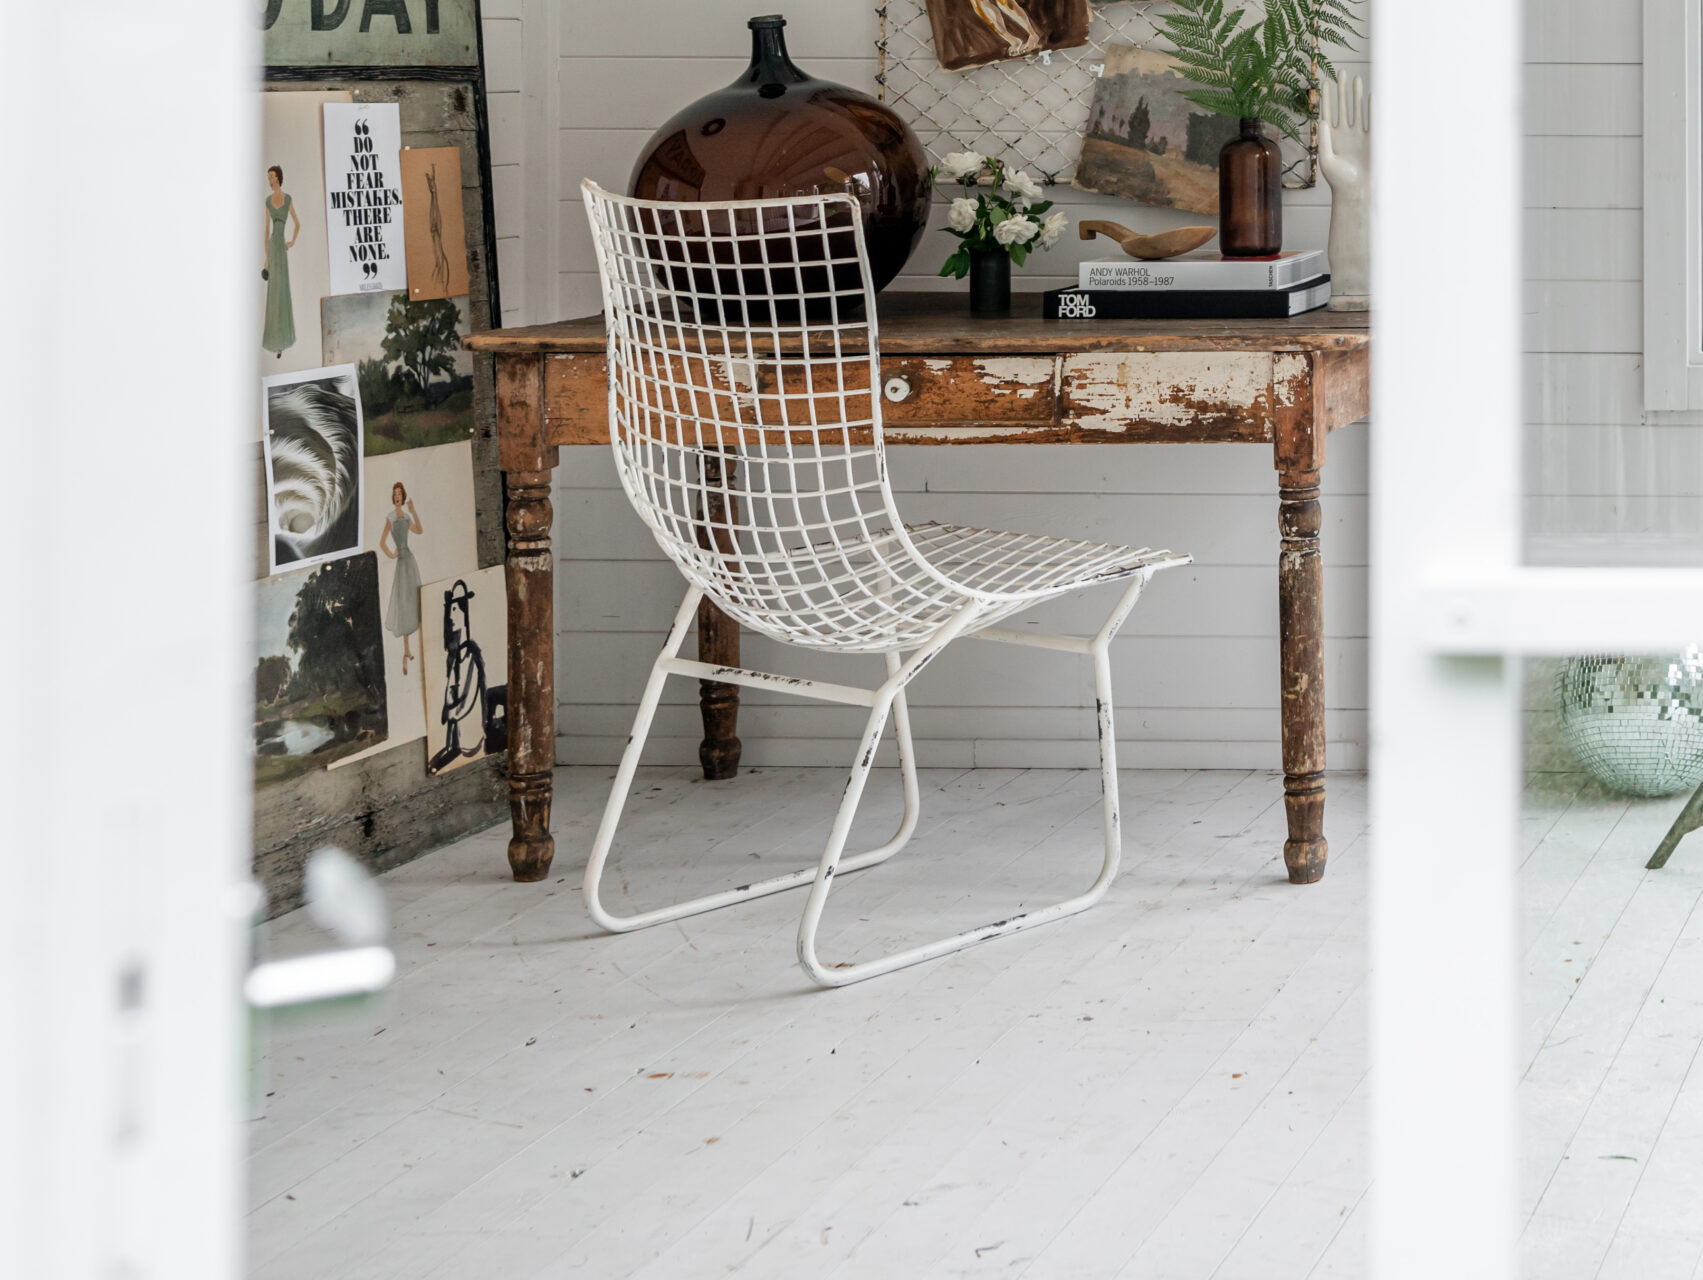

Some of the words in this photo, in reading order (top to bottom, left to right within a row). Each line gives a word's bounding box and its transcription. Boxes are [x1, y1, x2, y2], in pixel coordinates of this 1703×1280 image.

[353, 136, 373, 154] DO
[350, 154, 379, 172] NOT
[346, 171, 384, 190] FEAR
[330, 189, 402, 209] MISTAKES.
[343, 207, 391, 226] THERE
[354, 226, 383, 244] ARE
[349, 243, 390, 262] NONE.
[1089, 267, 1112, 277] ANDY
[1115, 267, 1151, 277] WARHOL
[1089, 277, 1126, 286] Polaroids
[1058, 294, 1089, 306] TOM
[1058, 305, 1097, 318] FORD
